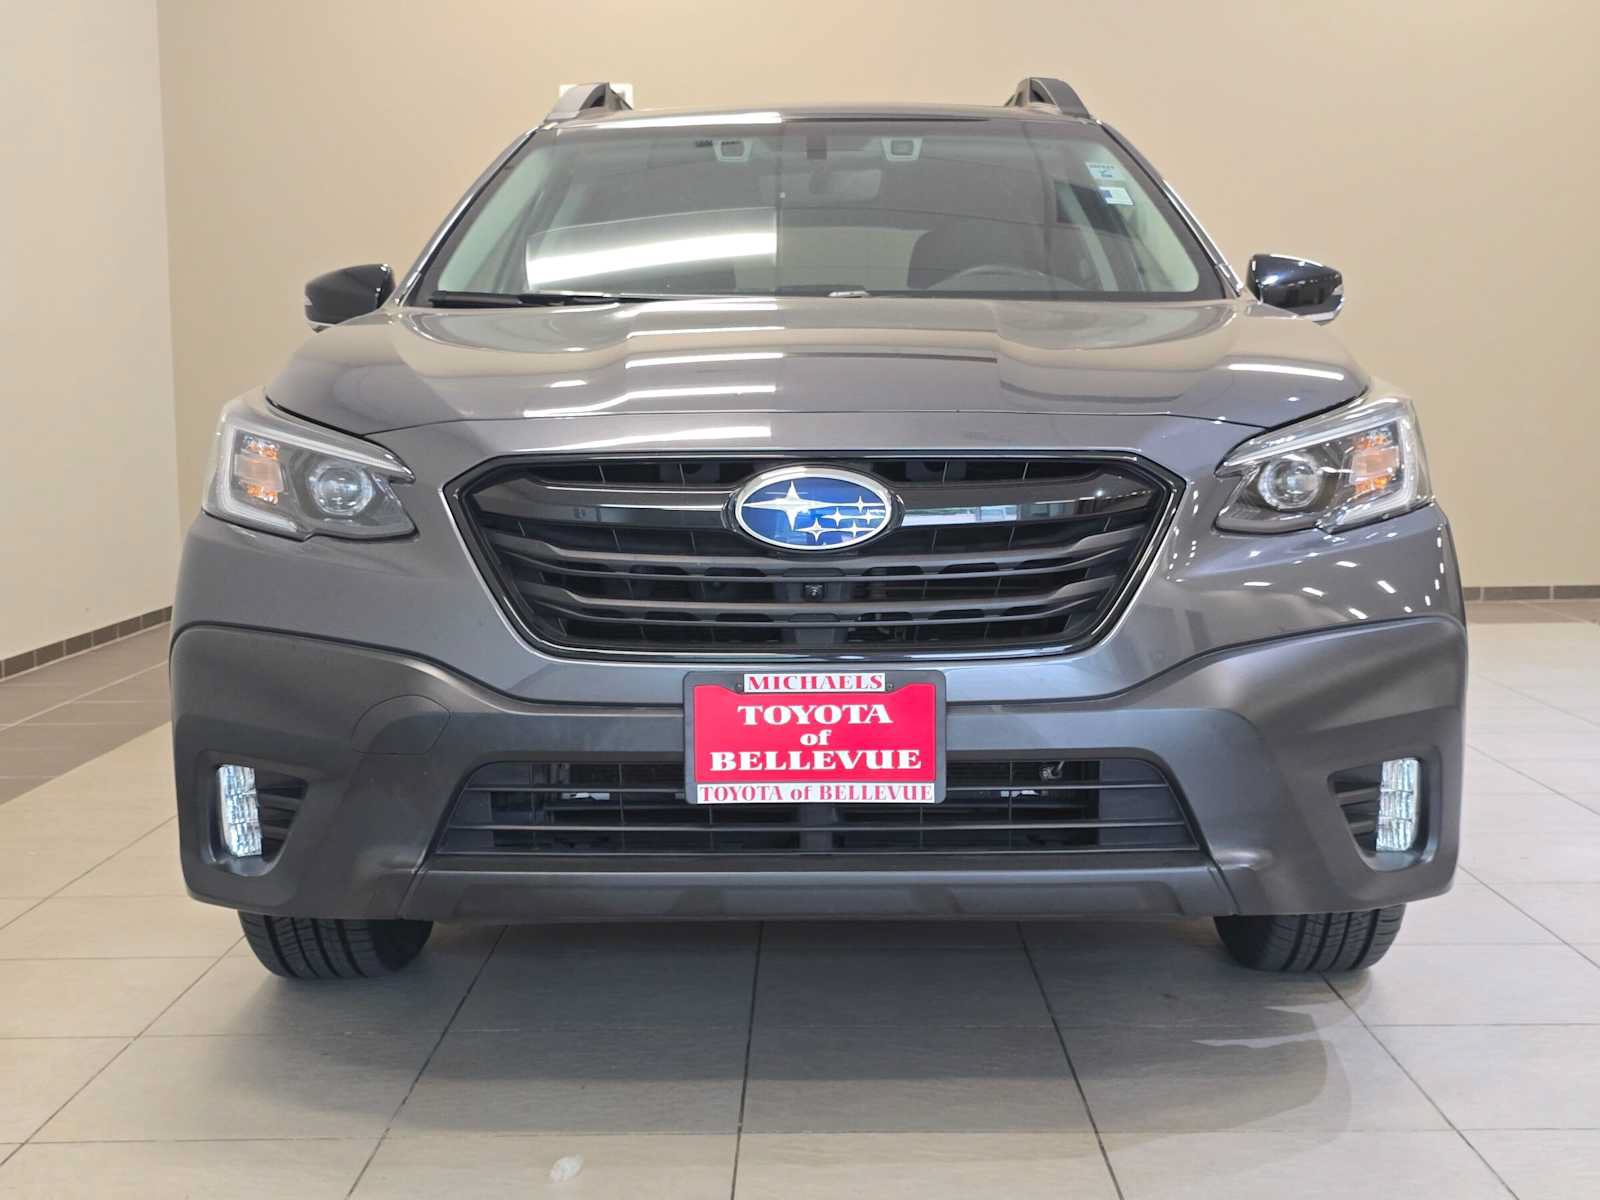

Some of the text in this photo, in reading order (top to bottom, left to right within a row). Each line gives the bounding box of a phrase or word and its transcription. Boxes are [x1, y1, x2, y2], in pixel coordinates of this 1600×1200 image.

[748, 675, 882, 690] MICHAELS
[738, 704, 893, 725] TOYOTA
[800, 730, 832, 746] of
[710, 749, 922, 771] BELLEVUE
[700, 785, 933, 801] TOYOTA of BELLEVUE
